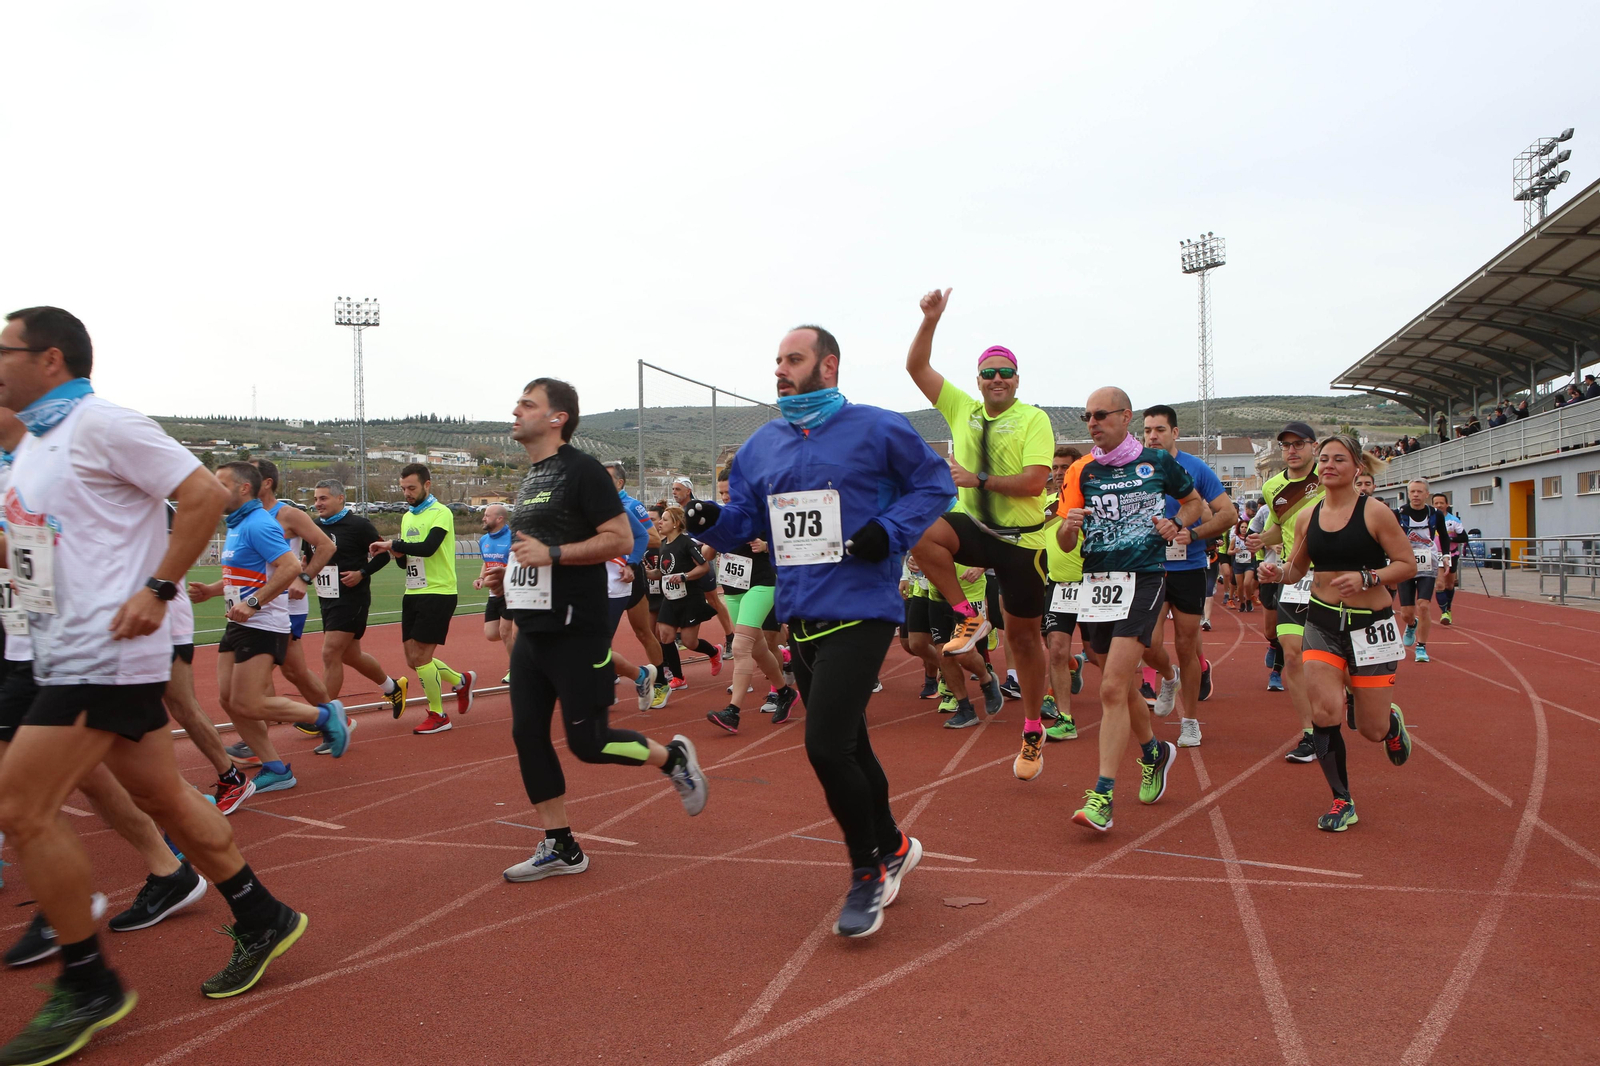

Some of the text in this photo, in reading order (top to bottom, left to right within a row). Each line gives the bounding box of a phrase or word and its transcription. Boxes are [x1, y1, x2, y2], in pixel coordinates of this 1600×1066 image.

[1091, 494, 1119, 520] 33
[783, 510, 822, 538] 373
[511, 565, 538, 587] 409
[725, 562, 745, 577] 455
[317, 574, 330, 586] 811
[1062, 588, 1078, 600] 141
[1092, 585, 1122, 604] 392
[1365, 623, 1396, 645] 818
